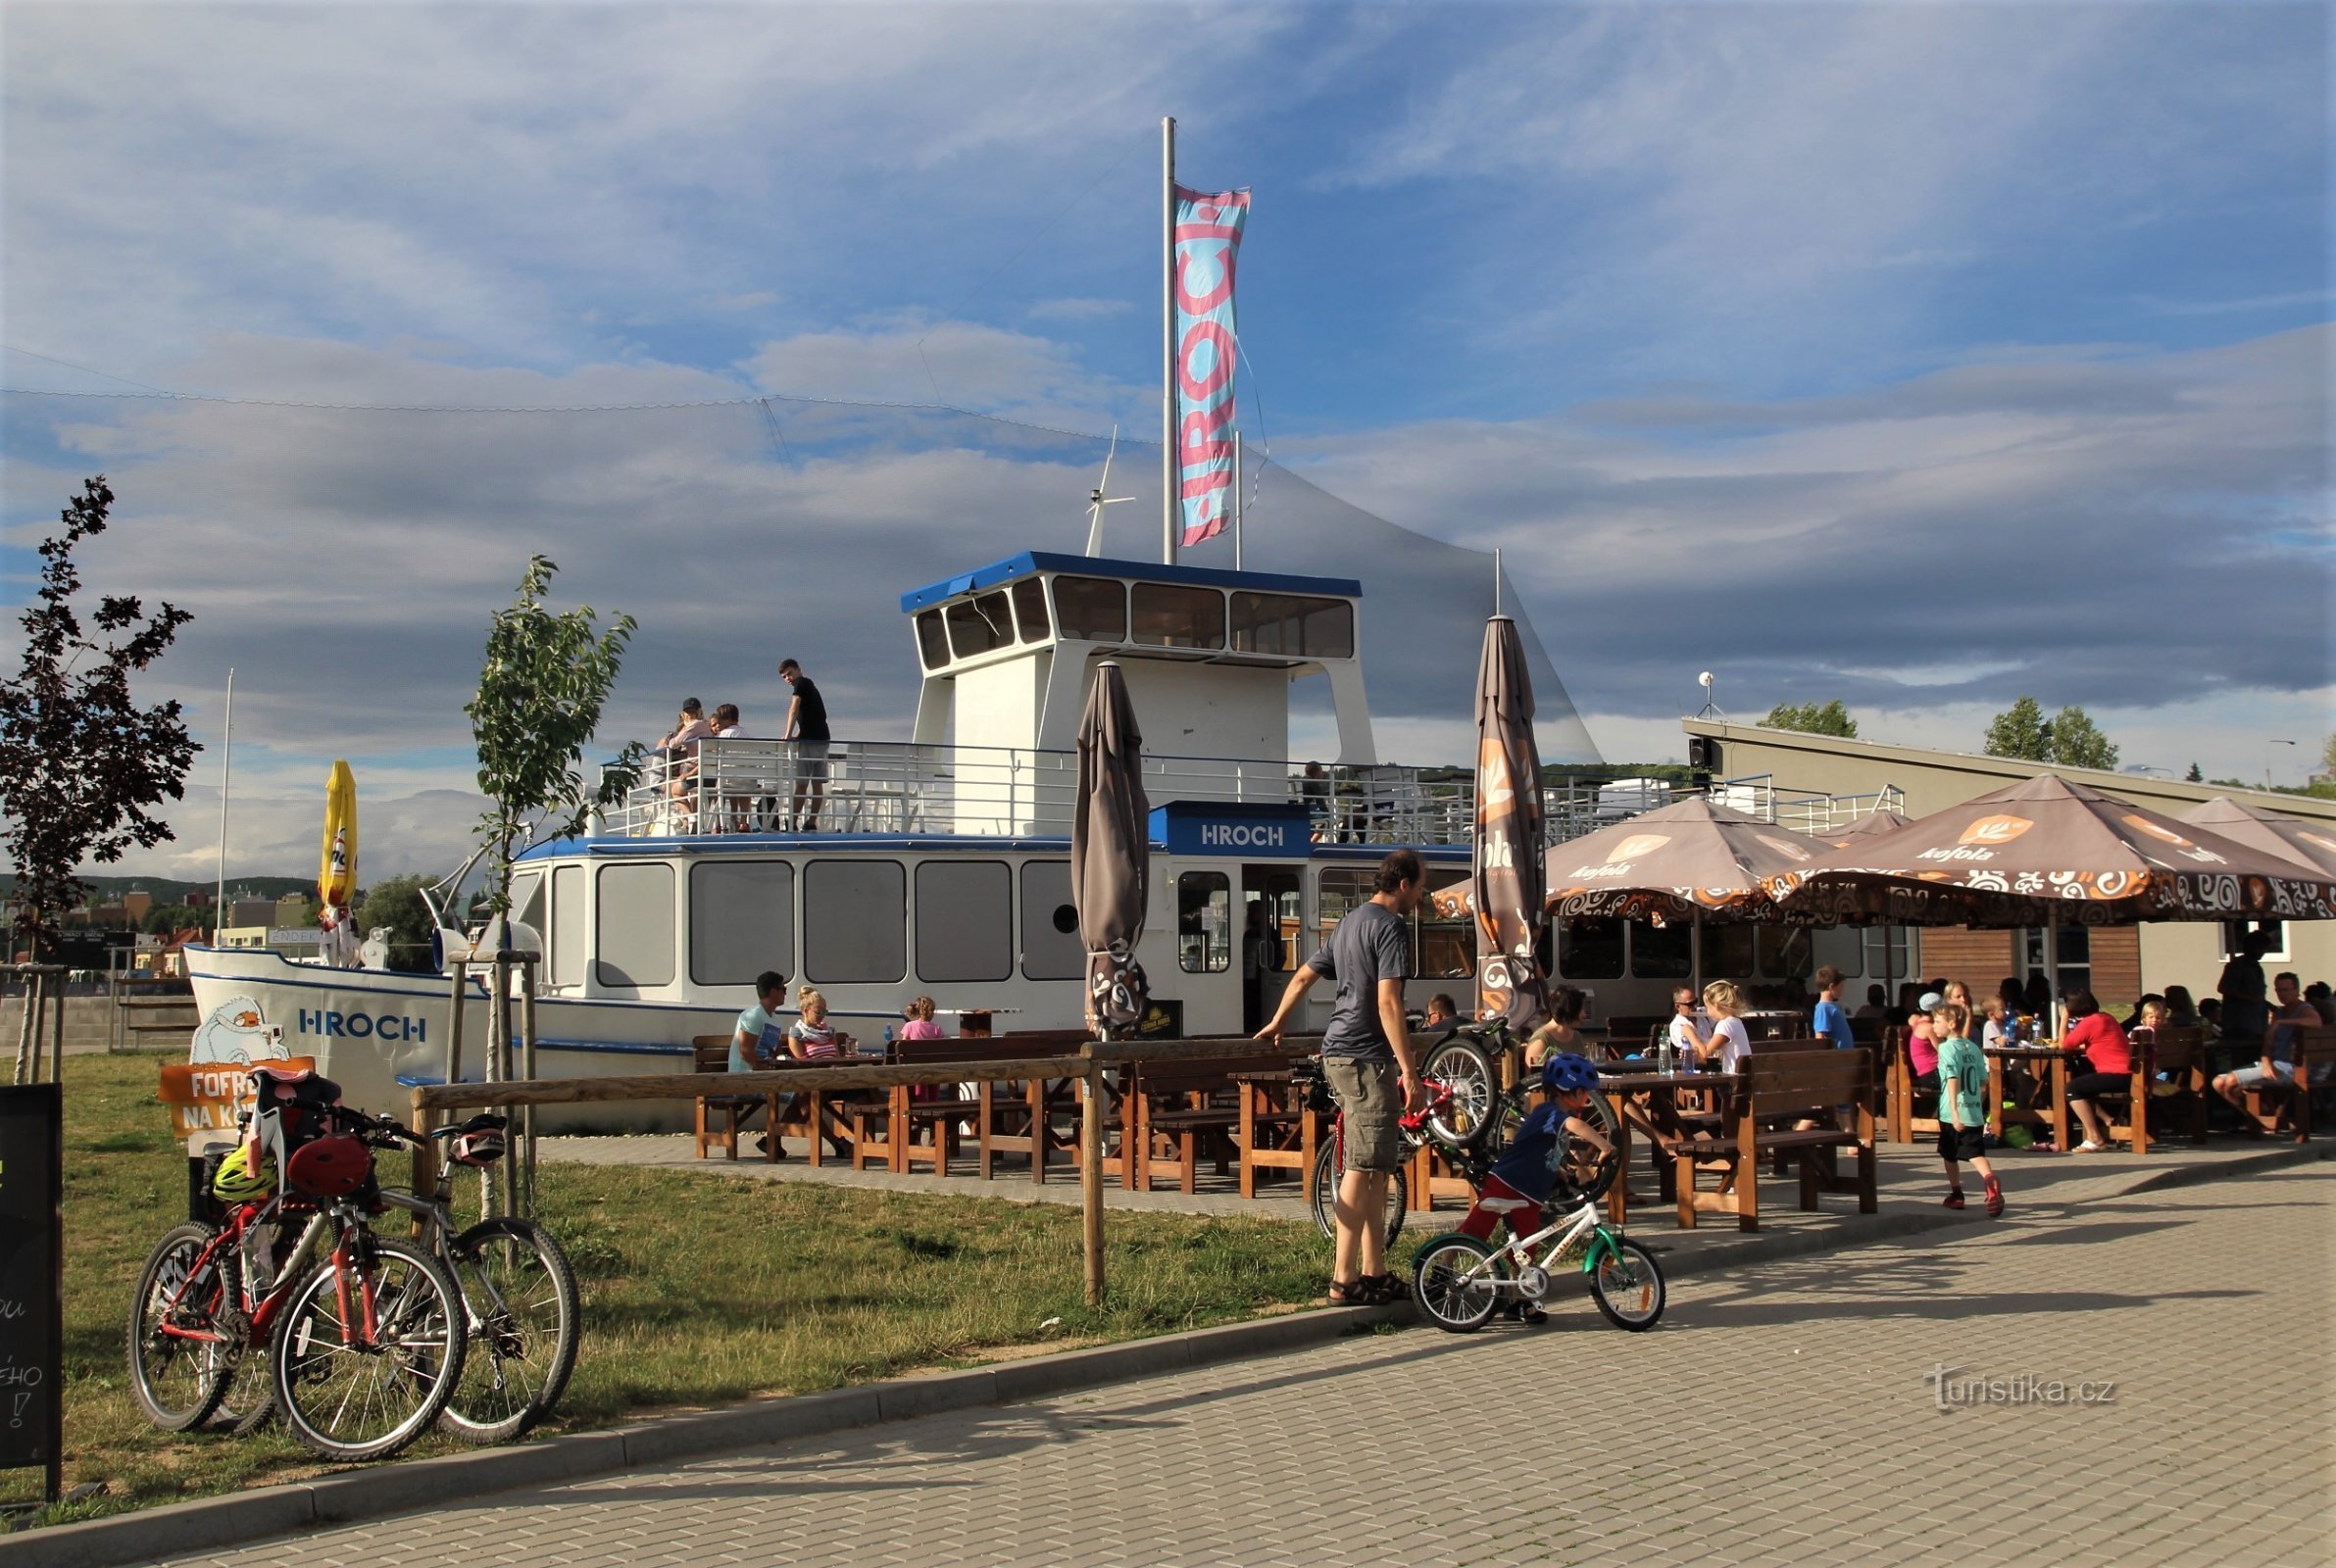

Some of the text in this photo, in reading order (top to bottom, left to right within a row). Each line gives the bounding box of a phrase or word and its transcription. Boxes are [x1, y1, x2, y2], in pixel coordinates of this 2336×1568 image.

[1202, 824, 1283, 847] HROCH
[1916, 846, 1995, 862] kofola
[1568, 862, 1632, 881] kofola
[299, 1008, 425, 1043] HROCH
[191, 1071, 258, 1097] FOFRE
[1961, 1065, 1977, 1097] 10
[183, 1105, 214, 1129] NA
